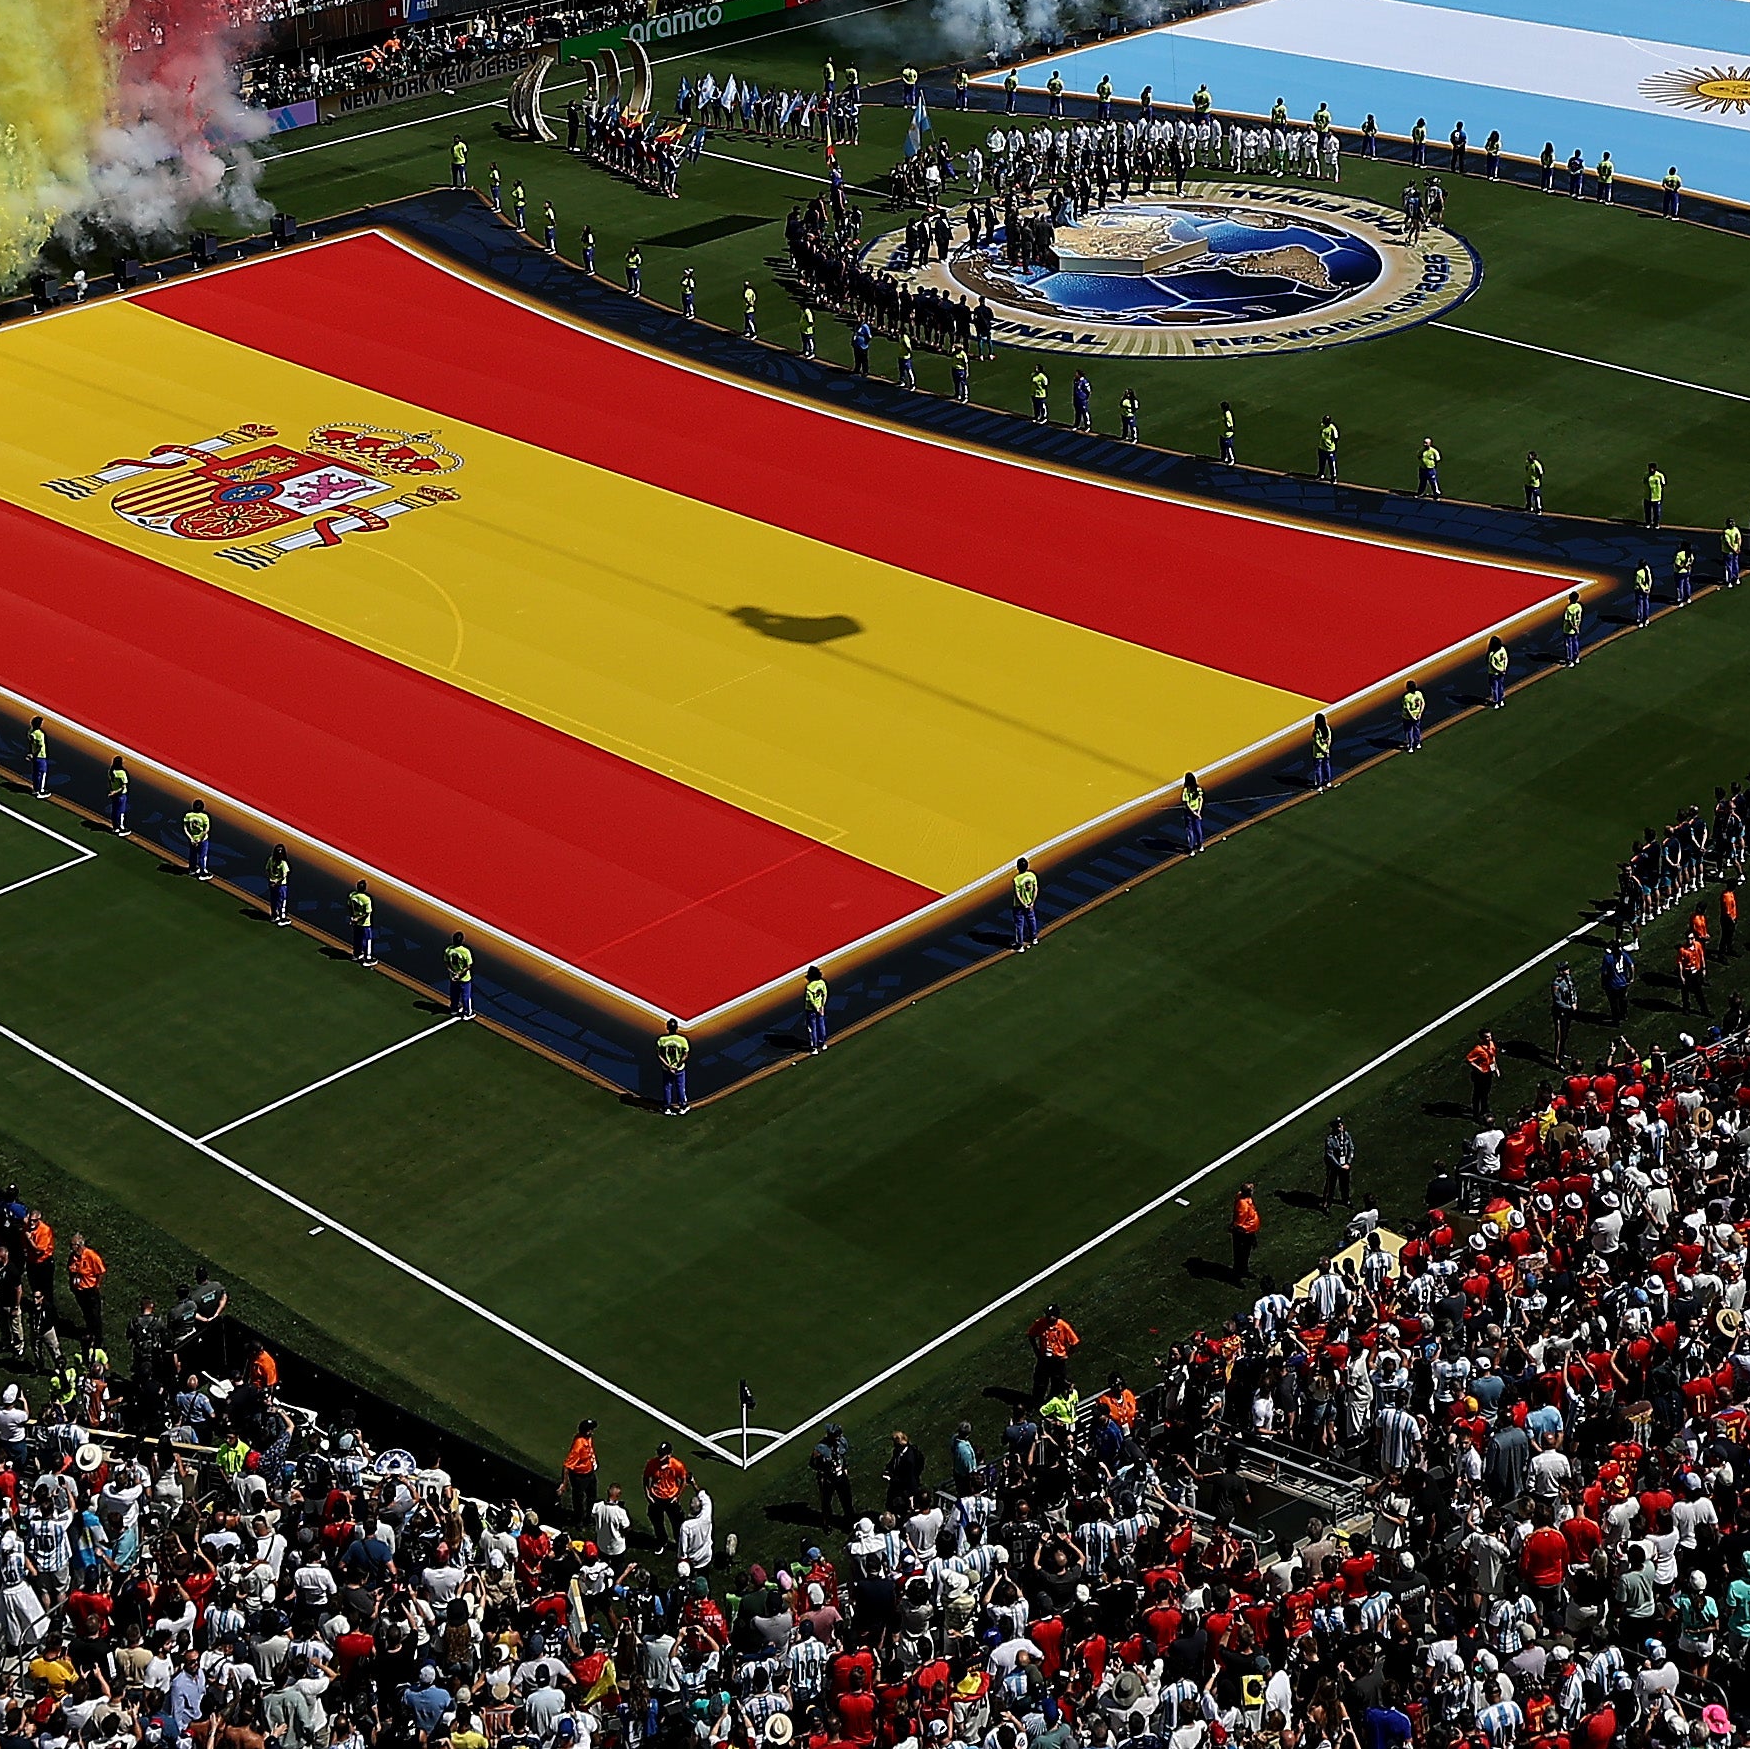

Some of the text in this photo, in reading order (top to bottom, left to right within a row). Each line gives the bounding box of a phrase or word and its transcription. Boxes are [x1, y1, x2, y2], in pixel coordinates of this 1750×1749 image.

[628, 4, 724, 44] aramco
[339, 50, 540, 112] NEW YORK NEW JERSEY
